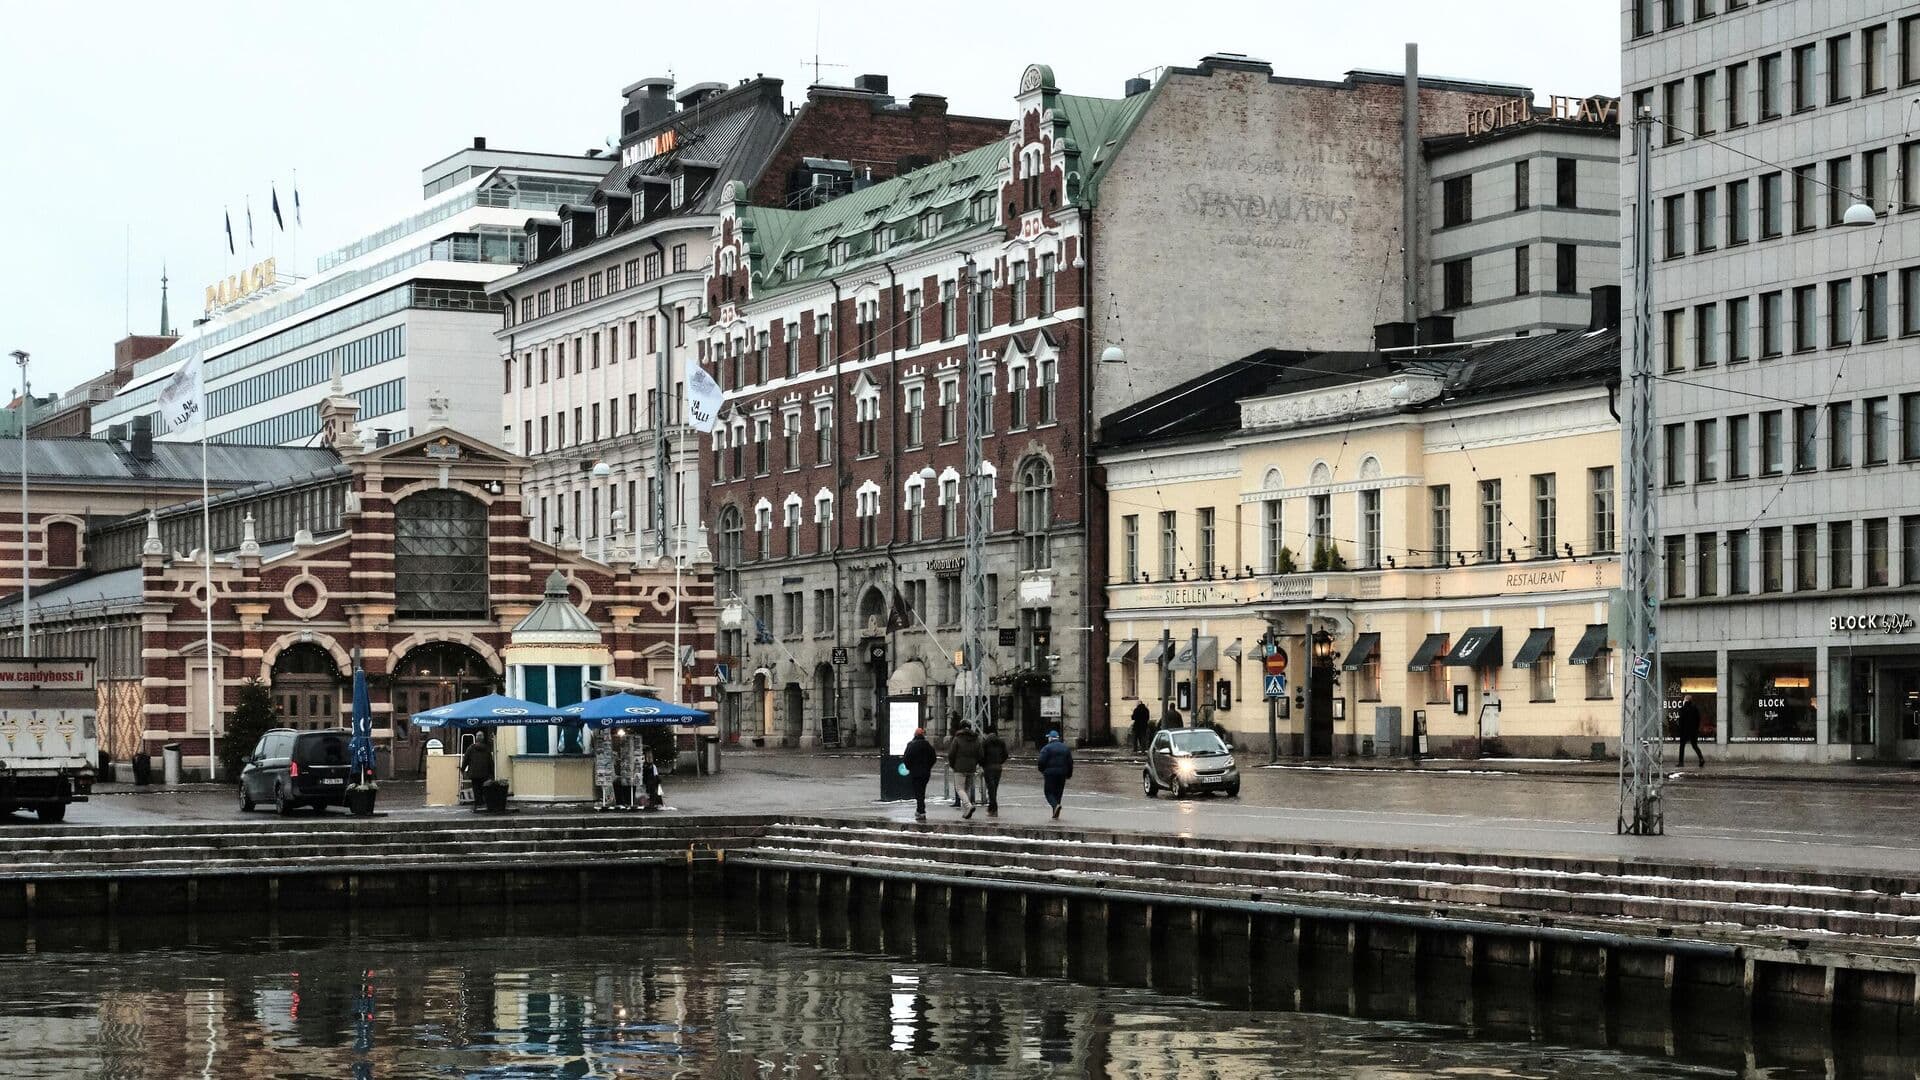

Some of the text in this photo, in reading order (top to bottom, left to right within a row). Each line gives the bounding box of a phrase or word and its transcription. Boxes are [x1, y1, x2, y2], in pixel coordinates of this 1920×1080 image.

[1465, 97, 1531, 137] HOTEL
[205, 256, 276, 314] PALACE
[929, 558, 961, 570] GOODWIN
[1506, 570, 1567, 587] RESTAURANT
[1165, 589, 1180, 605] SUE
[1182, 587, 1208, 604] ELLEN
[1830, 613, 1914, 634] BLOCK by Dylan
[1758, 698, 1785, 708] BLOCK
